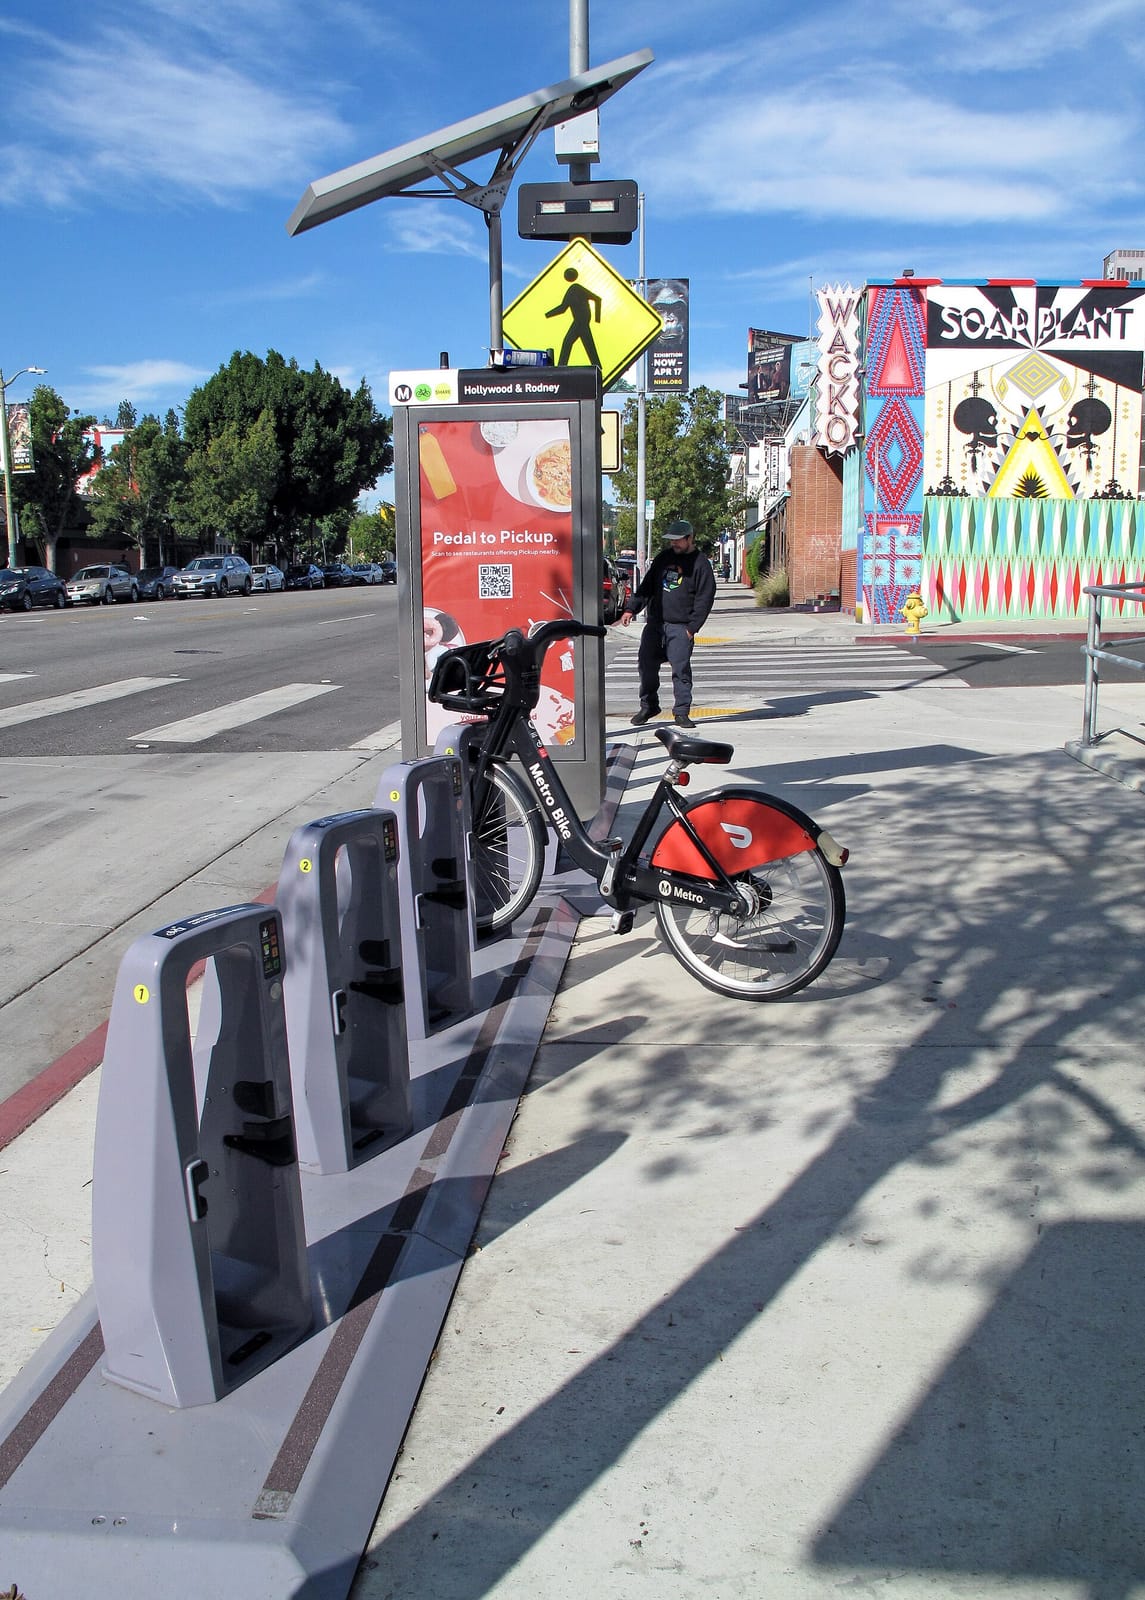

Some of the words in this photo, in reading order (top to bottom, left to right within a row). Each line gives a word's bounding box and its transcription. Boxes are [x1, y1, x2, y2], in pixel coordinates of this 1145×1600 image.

[940, 307, 1028, 340] SOAP
[1038, 307, 1134, 339] PLANT
[654, 359, 676, 367] NOW
[654, 368, 672, 376] APR
[673, 368, 682, 376] 17
[826, 298, 854, 448] WACKO
[464, 383, 512, 395] Hollywood
[515, 384, 522, 393] &
[525, 383, 560, 394] Rodney
[433, 531, 477, 545] Pedal
[480, 532, 496, 544] to
[500, 530, 558, 546] Pickup.
[496, 549, 518, 557] offering
[529, 762, 555, 807] Metro
[552, 808, 571, 840] Bike
[303, 861, 309, 871] 2
[674, 886, 704, 904] Metro
[139, 988, 145, 1000] 1
